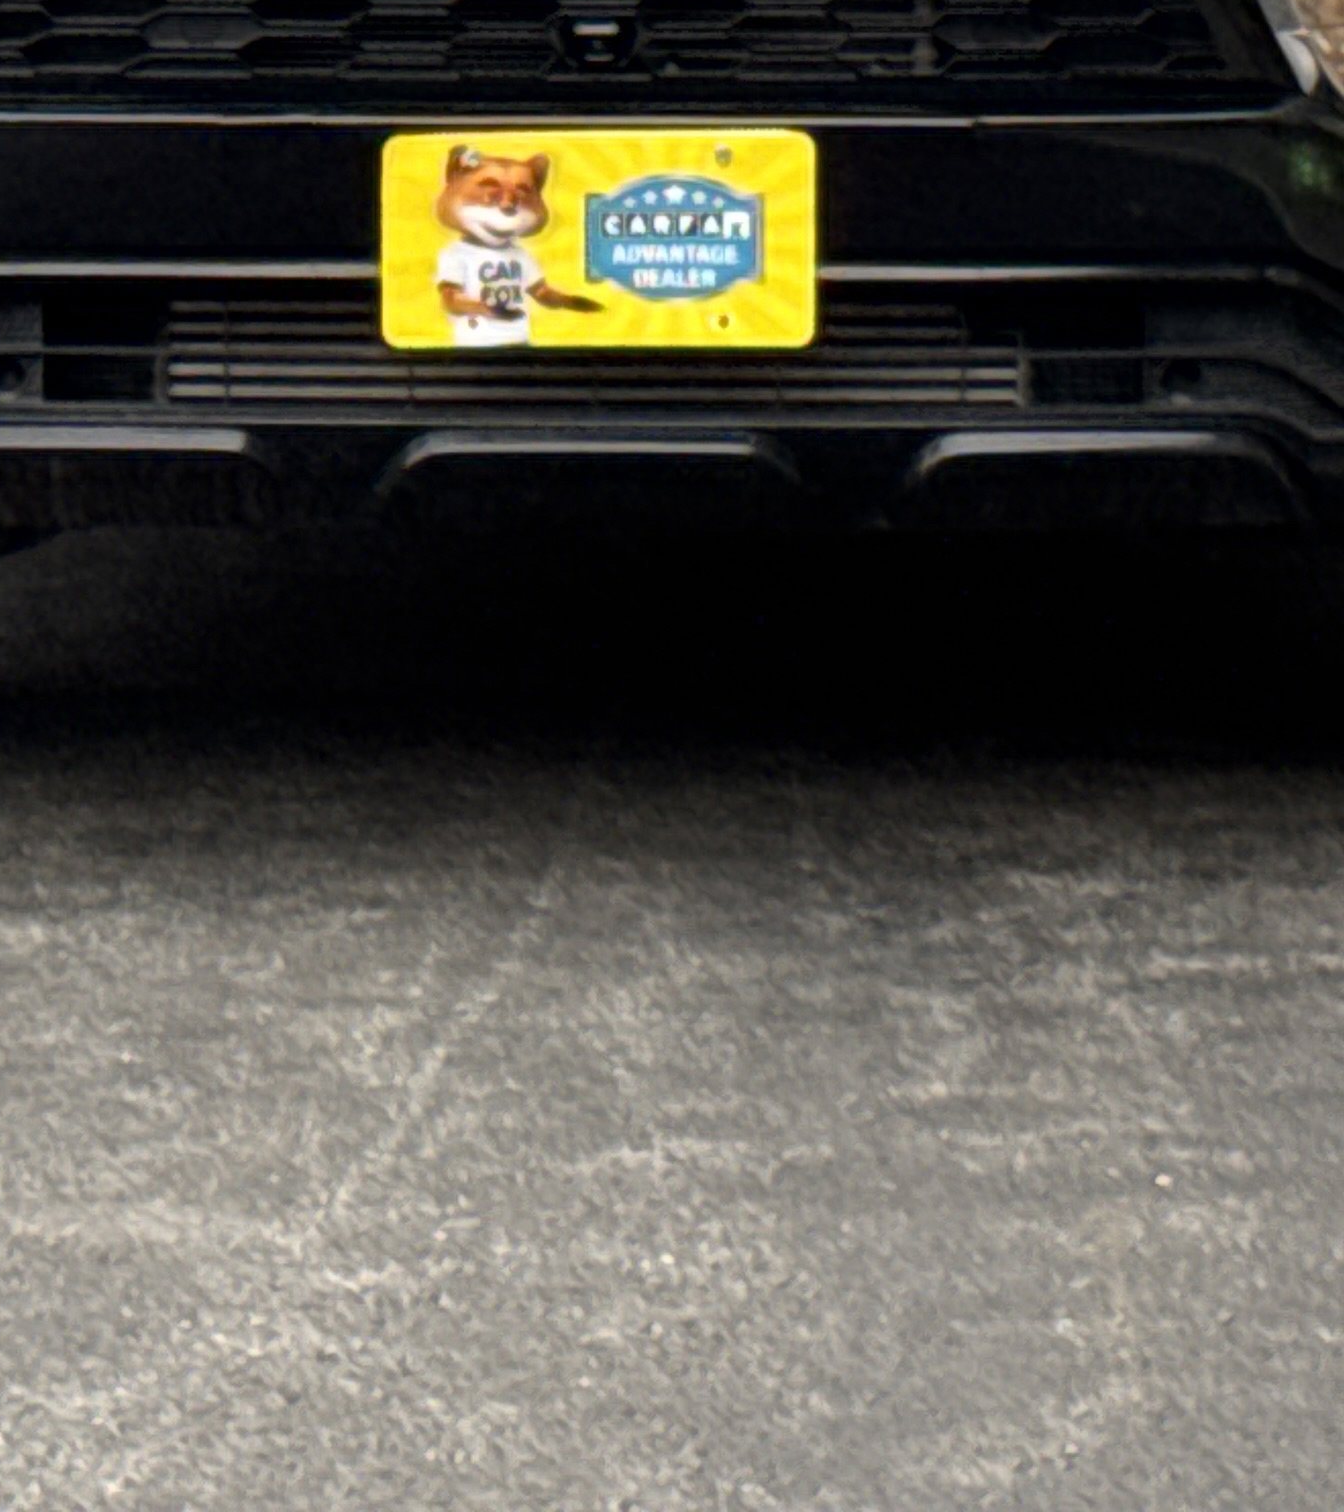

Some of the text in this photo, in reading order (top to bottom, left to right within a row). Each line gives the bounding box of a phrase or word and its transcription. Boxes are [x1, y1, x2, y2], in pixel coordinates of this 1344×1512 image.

[612, 243, 740, 265] ADVANTAGE
[478, 259, 522, 283] CAR
[632, 267, 717, 288] DEALER
